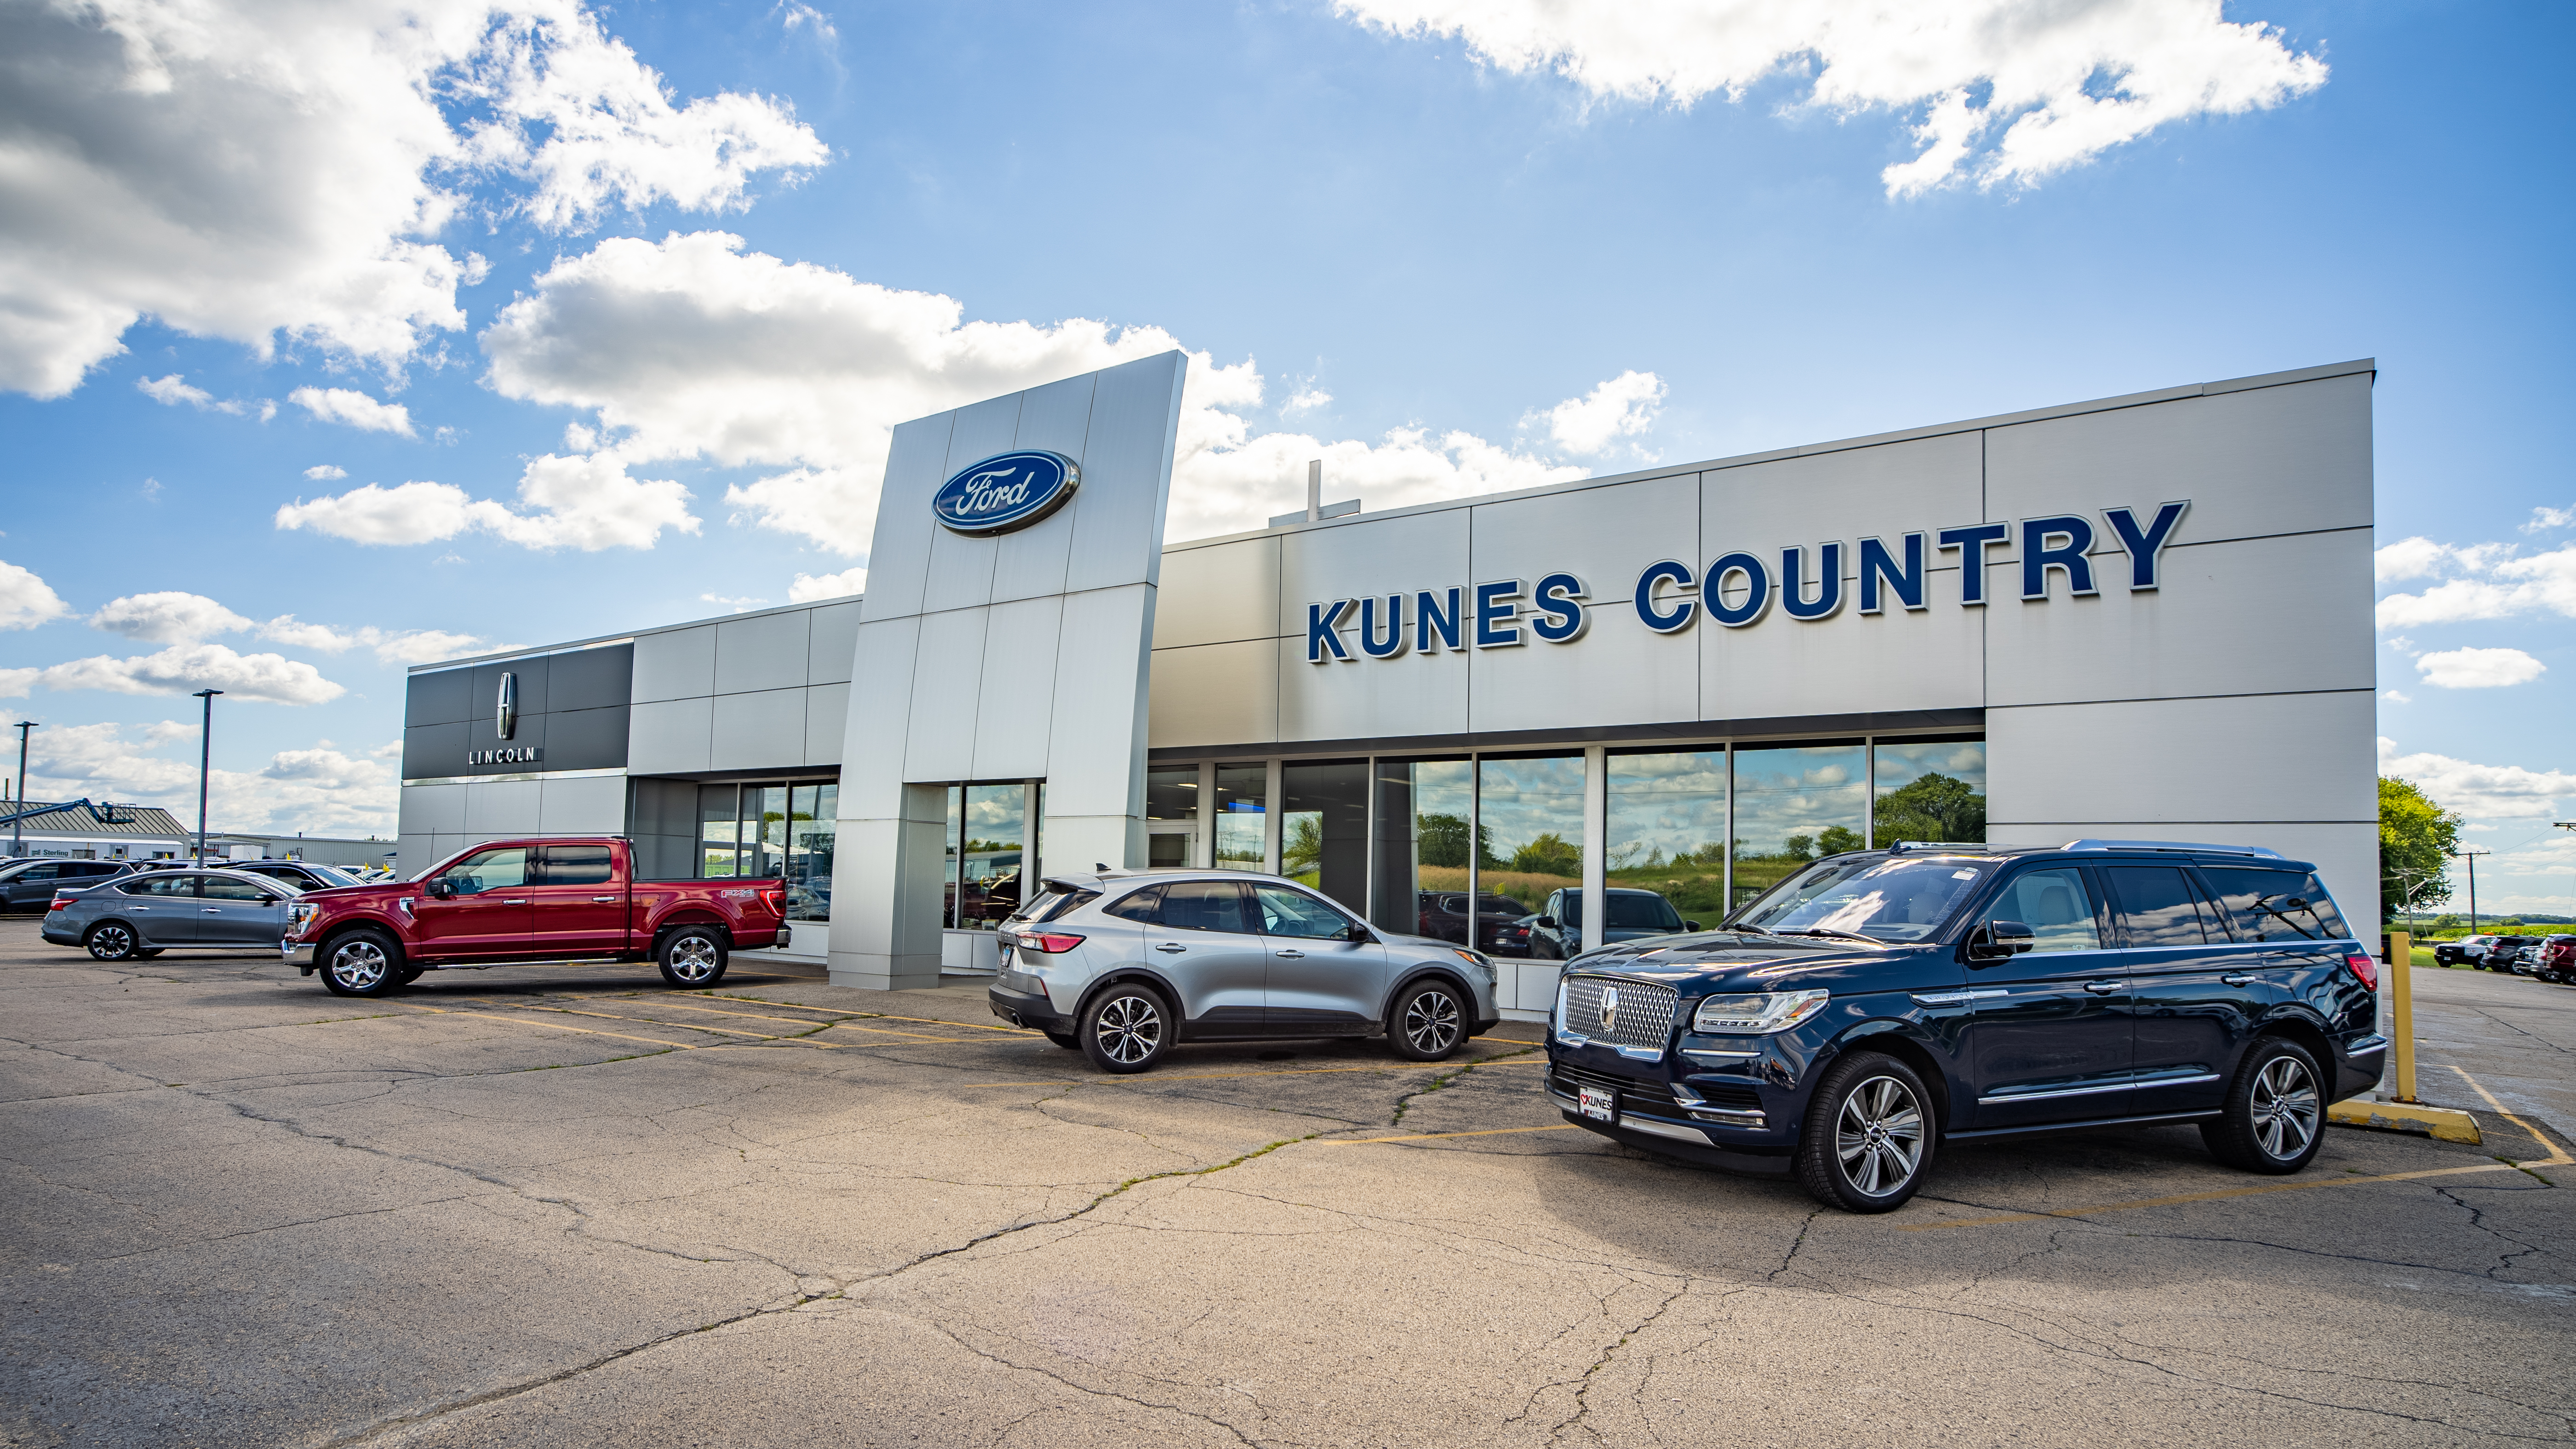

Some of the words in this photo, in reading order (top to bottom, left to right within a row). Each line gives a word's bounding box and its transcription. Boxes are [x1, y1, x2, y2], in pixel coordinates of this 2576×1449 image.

[955, 467, 1035, 515] Ford
[1306, 571, 1588, 664] KUNES
[1631, 499, 2192, 634] COUNTRY
[469, 746, 534, 765] LINCOLN
[721, 889, 755, 898] FX4
[1586, 1094, 1612, 1111] KUNES
[1588, 1110, 1604, 1120] KUNES
